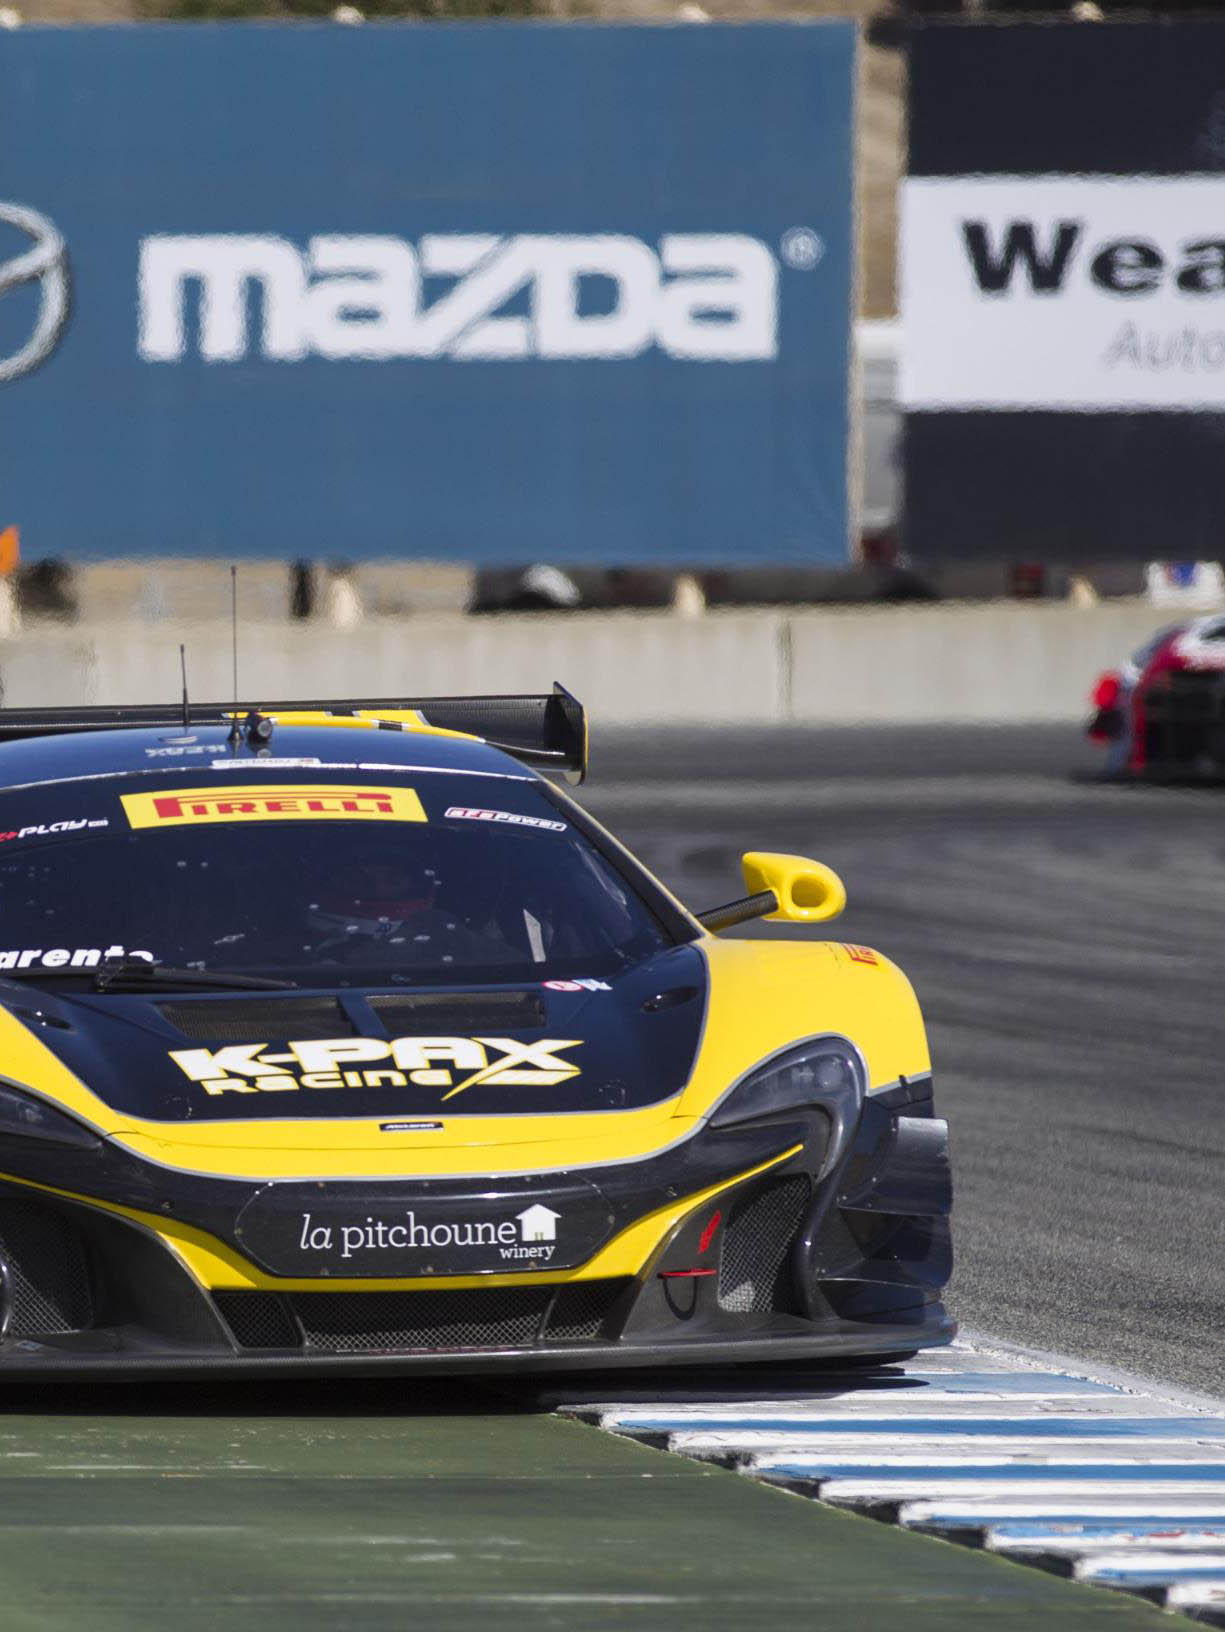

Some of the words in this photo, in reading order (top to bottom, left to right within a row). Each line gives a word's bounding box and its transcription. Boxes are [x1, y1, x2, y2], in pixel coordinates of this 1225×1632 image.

[958, 217, 1225, 294] Wea
[152, 791, 394, 819] PIRELLI
[167, 1036, 586, 1101] K-PAX
[300, 1214, 332, 1249] la
[341, 1211, 517, 1257] pitchoune
[499, 1245, 556, 1260] winery
